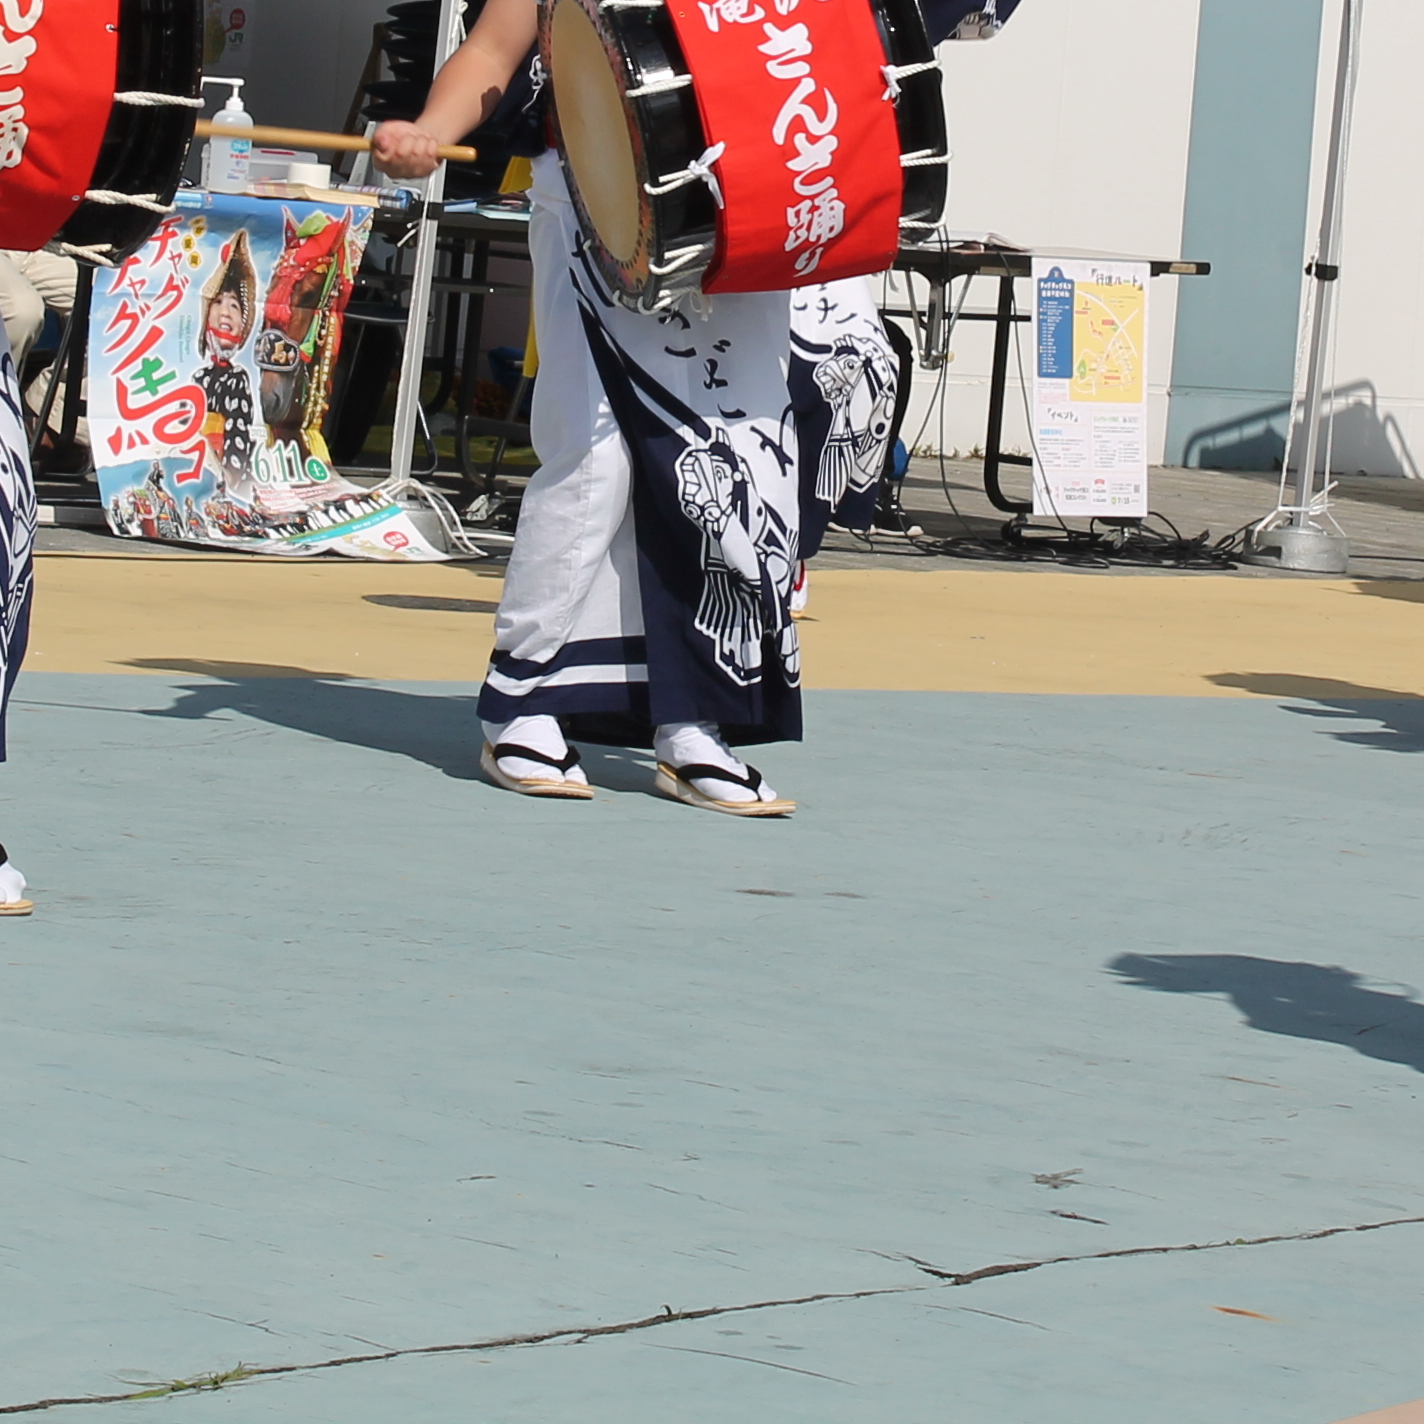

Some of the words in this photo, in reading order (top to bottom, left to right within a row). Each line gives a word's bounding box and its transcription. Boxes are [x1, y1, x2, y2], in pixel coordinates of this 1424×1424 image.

[757, 22, 846, 277] さんさ踊り
[147, 216, 190, 321] チャグ
[254, 441, 307, 484] 6.11
